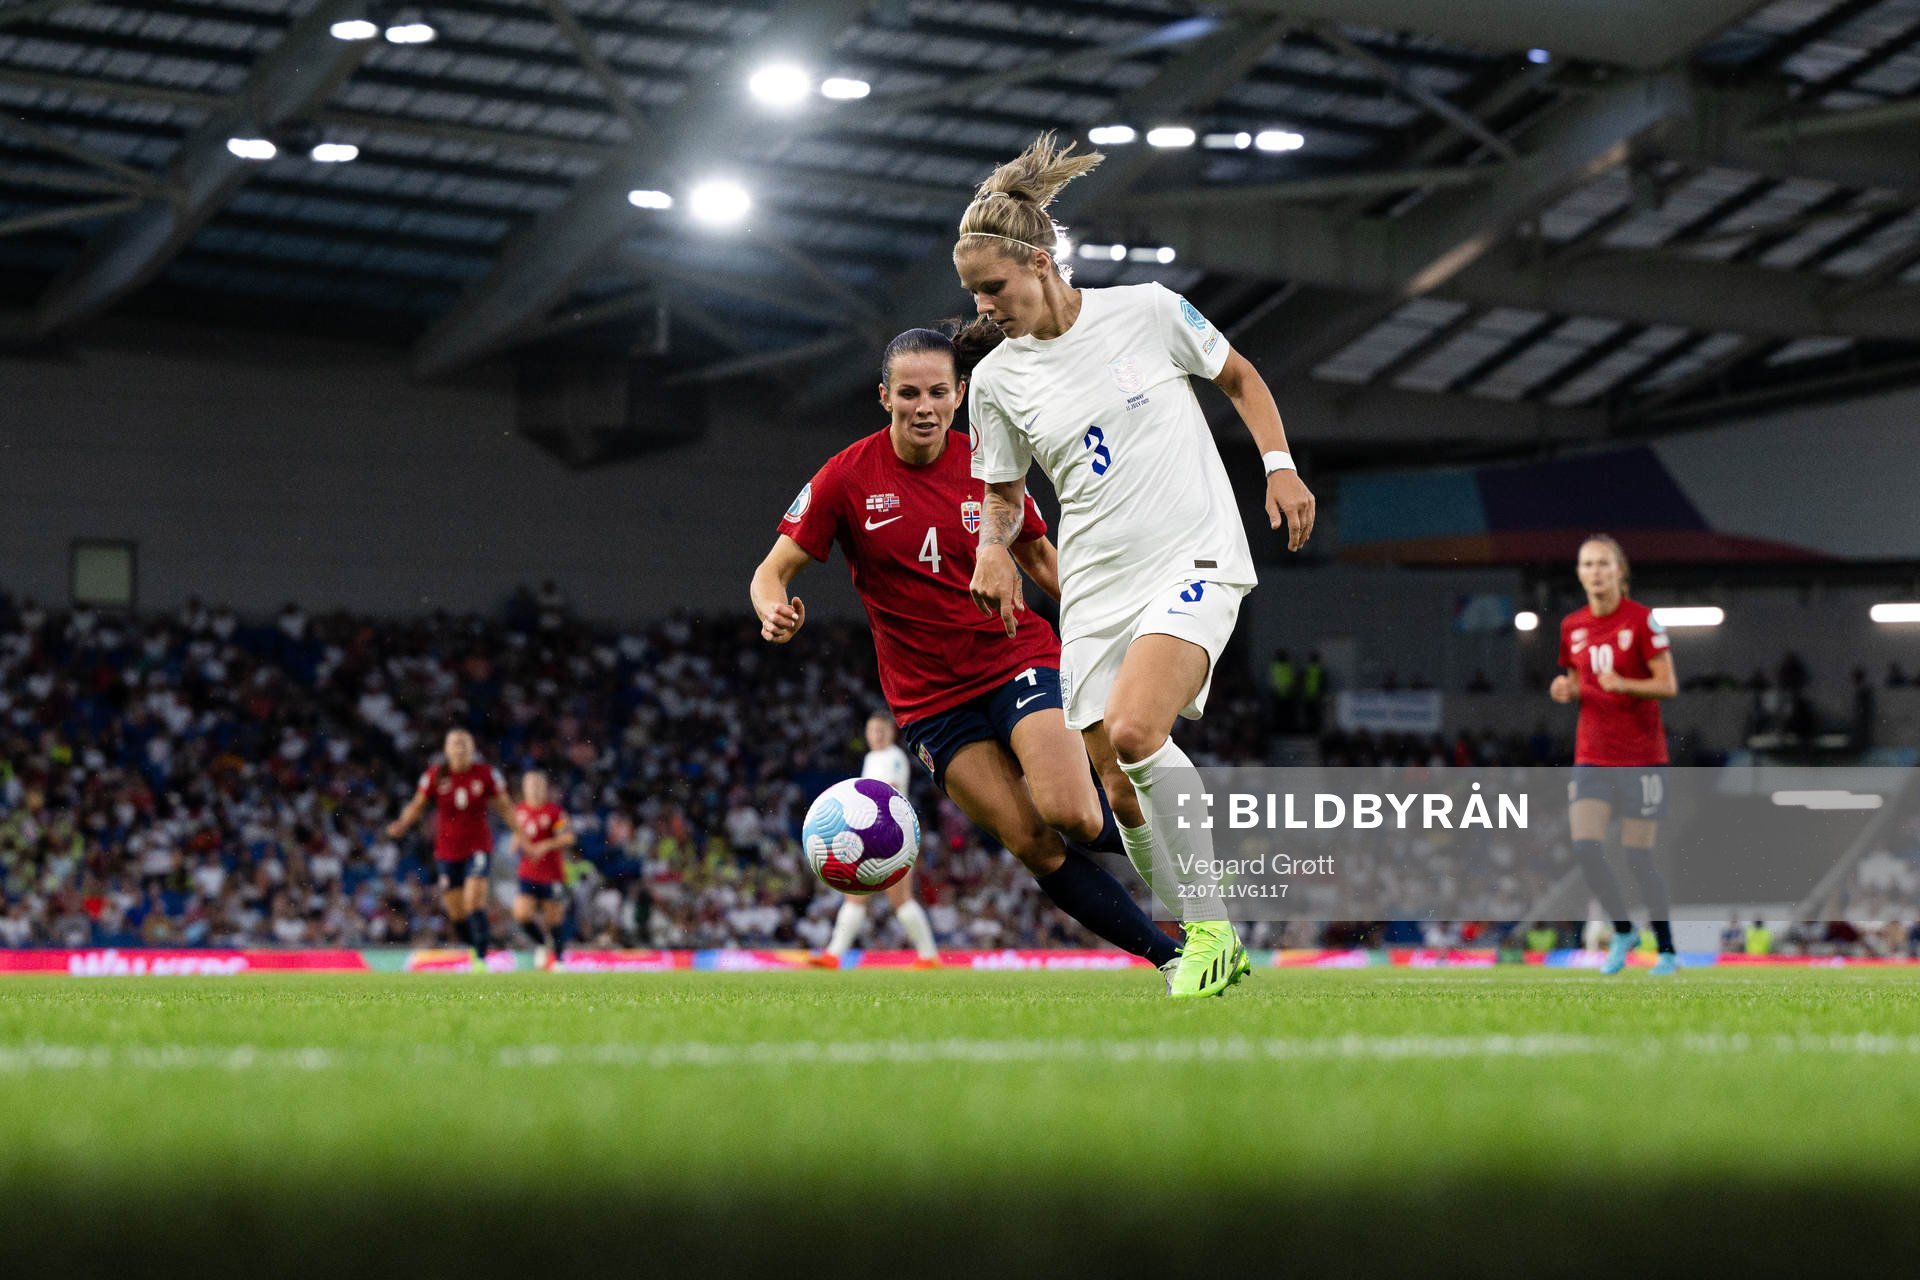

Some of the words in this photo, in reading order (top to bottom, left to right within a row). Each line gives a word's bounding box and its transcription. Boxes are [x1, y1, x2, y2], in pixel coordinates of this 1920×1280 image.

[1083, 425, 1111, 476] 3
[918, 526, 941, 573] 4
[1589, 643, 1614, 674] 10
[1640, 774, 1663, 806] 10
